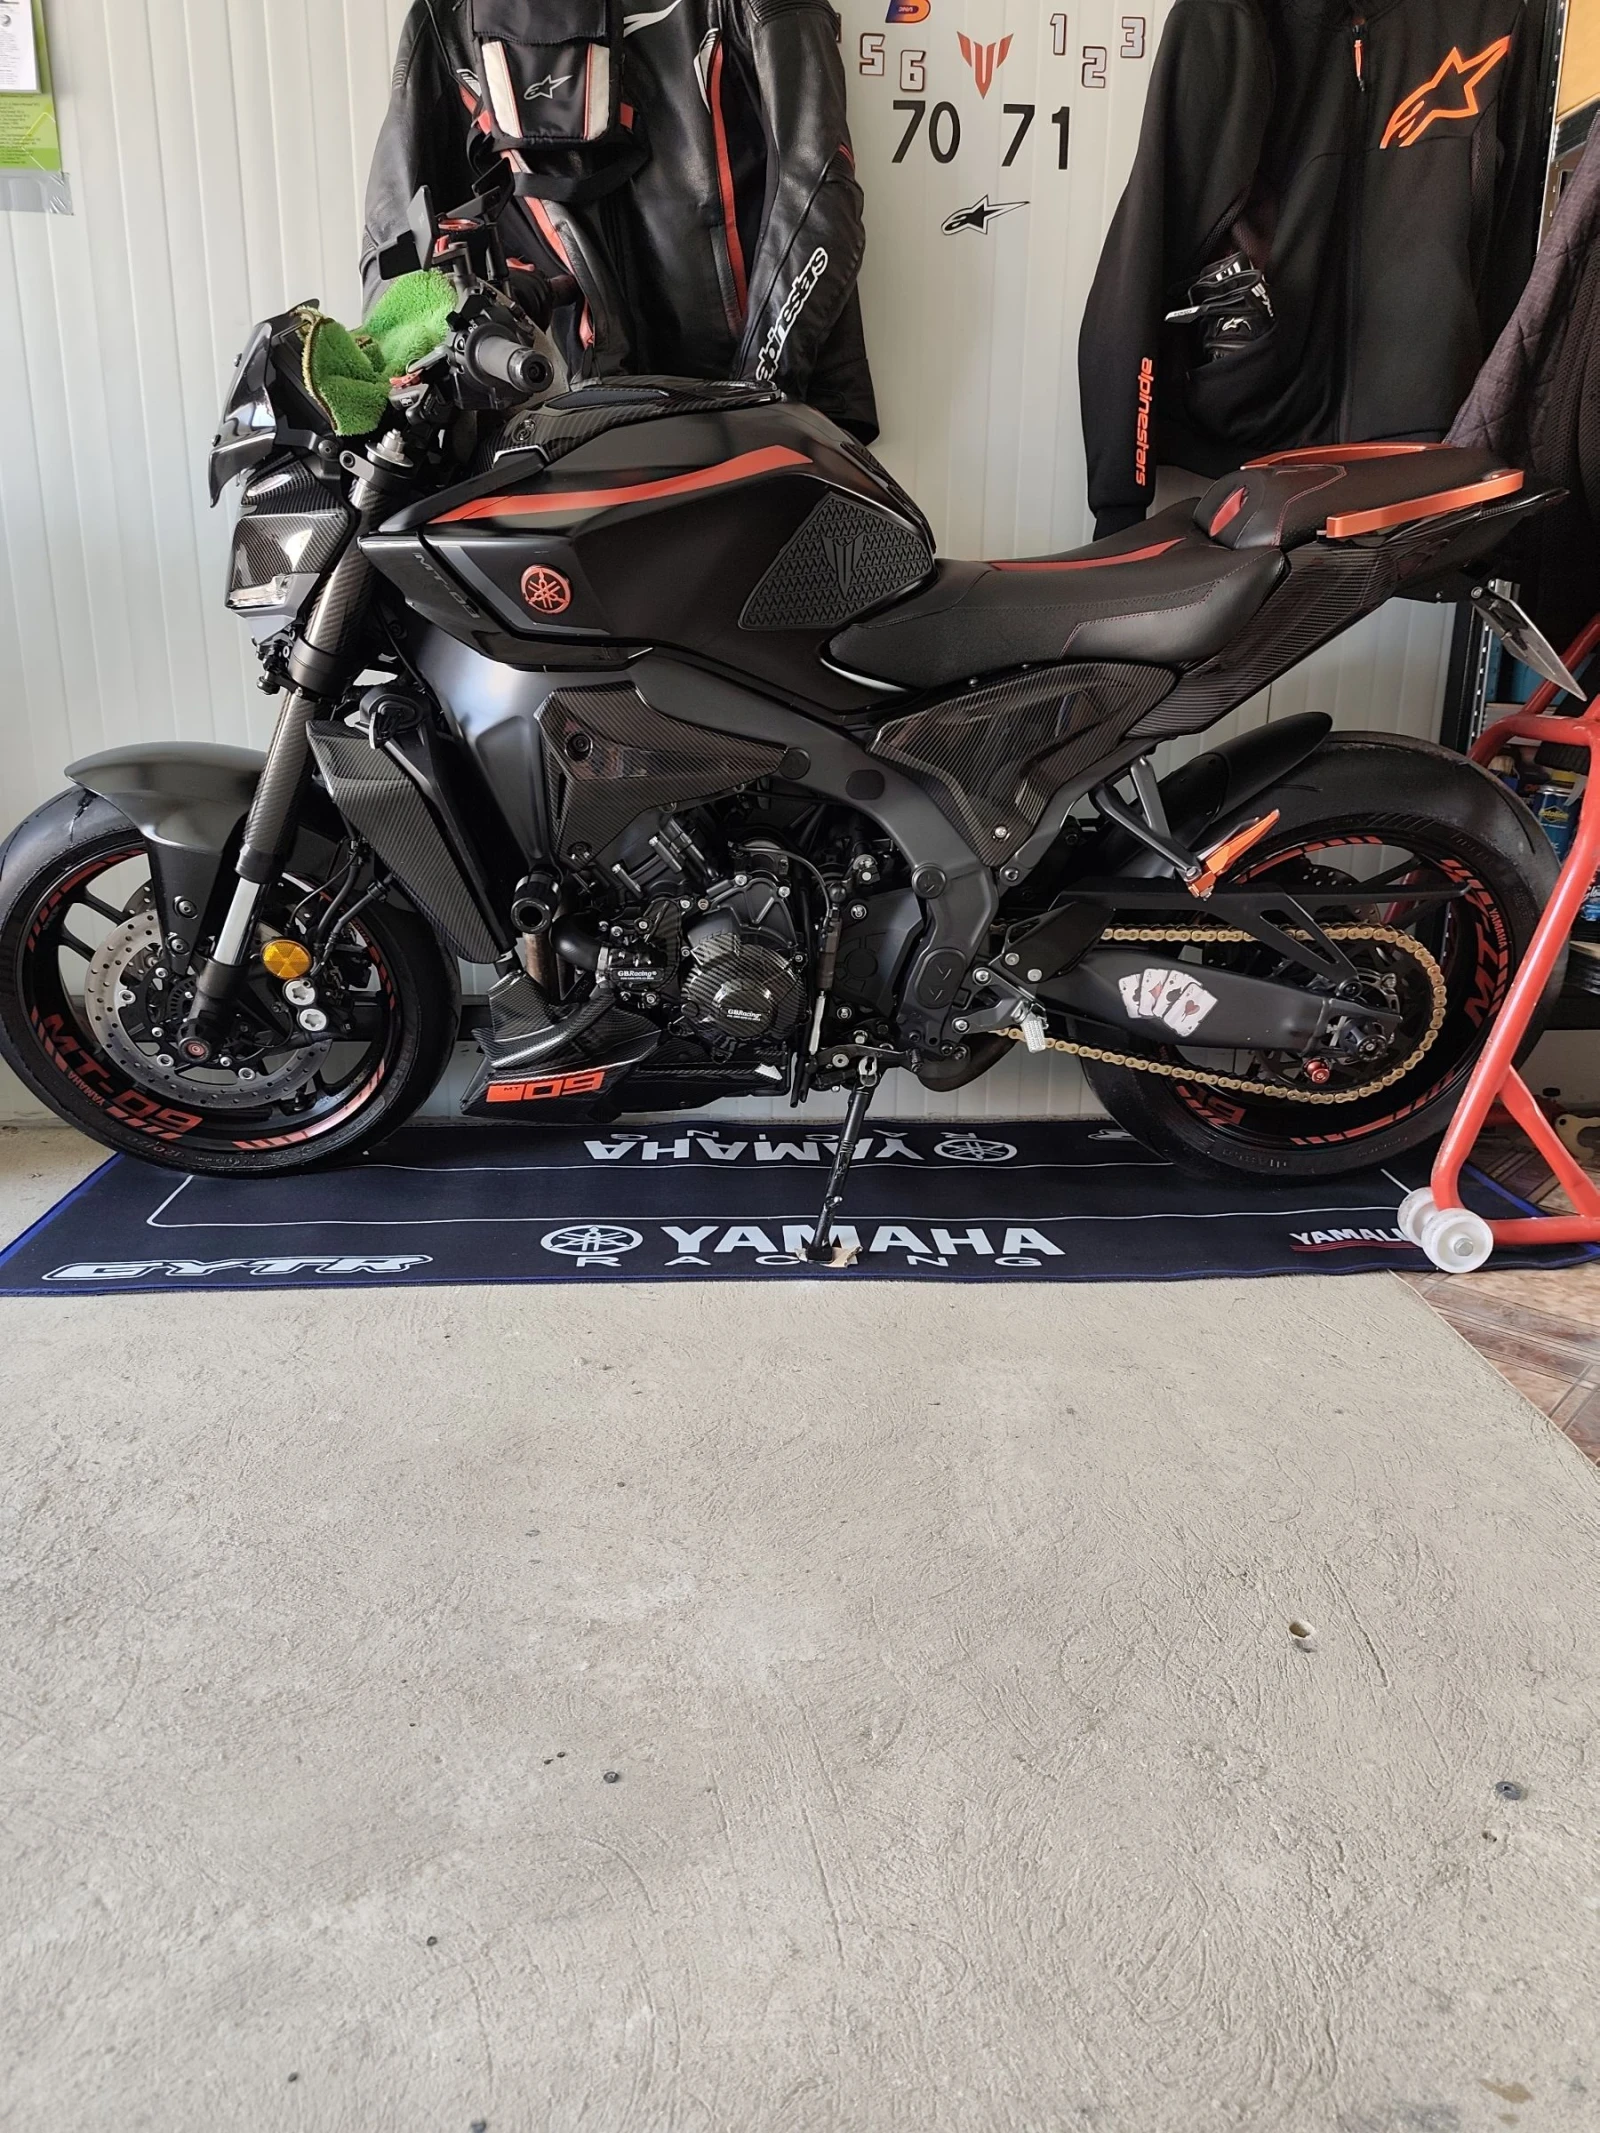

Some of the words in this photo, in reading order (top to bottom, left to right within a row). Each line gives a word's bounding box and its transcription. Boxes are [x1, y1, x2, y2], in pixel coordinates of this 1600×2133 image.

[859, 33, 885, 76] 5
[900, 49, 926, 92] 6
[1050, 13, 1067, 56] 1
[1081, 46, 1107, 88] 2
[1120, 16, 1146, 58] 3
[891, 100, 961, 164] 70
[1001, 103, 1070, 170] 71
[1135, 357, 1154, 486] alpinestars
[1489, 907, 1508, 948] YAMAHA
[44, 1014, 203, 1133] MT-09
[67, 1070, 106, 1106] YAMAHA
[523, 1071, 605, 1100] 09
[661, 1225, 1065, 1256] YAMAHA
[44, 1256, 430, 1279] GYTR
[576, 1256, 1041, 1267] RACNG
